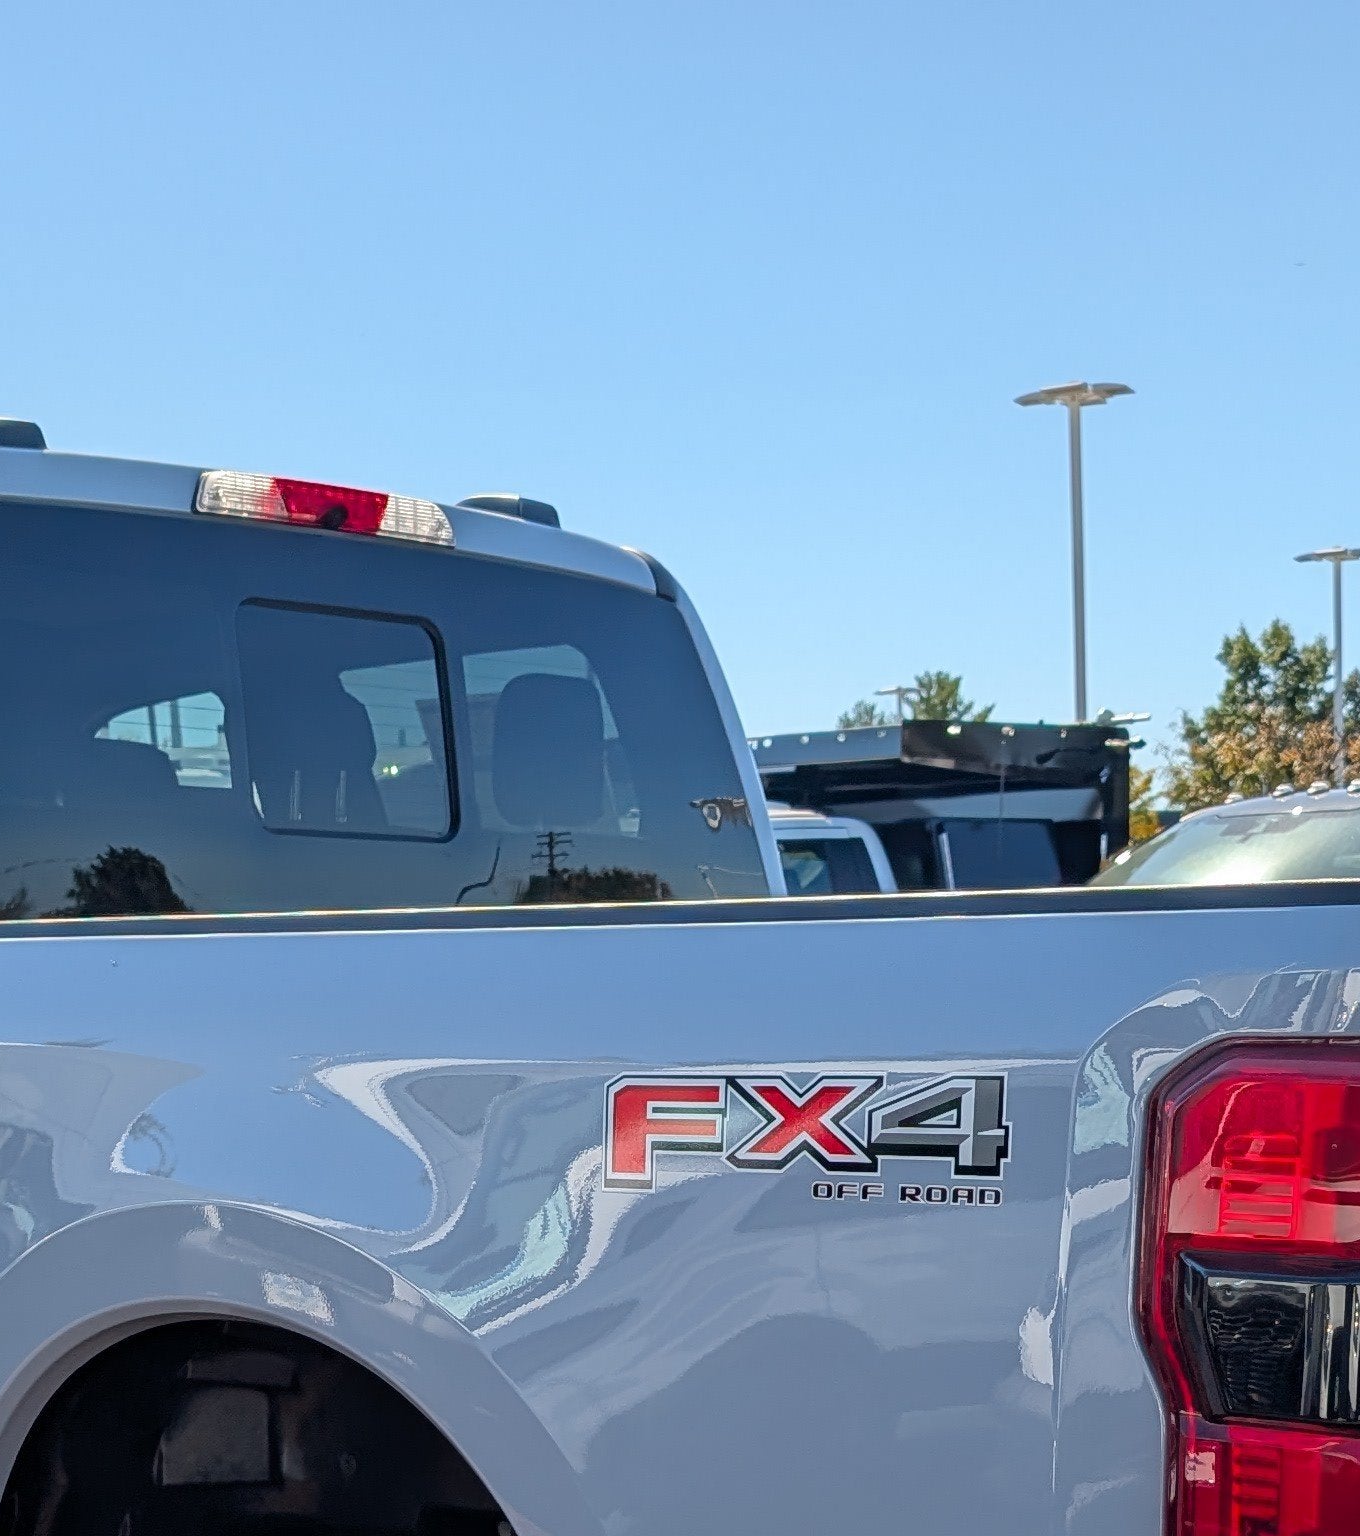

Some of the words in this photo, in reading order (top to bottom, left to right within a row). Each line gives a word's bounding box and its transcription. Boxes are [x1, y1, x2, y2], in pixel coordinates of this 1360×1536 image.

[602, 1071, 1012, 1193] FX4
[811, 1181, 884, 1201] OFF
[899, 1183, 1003, 1207] ROAD
